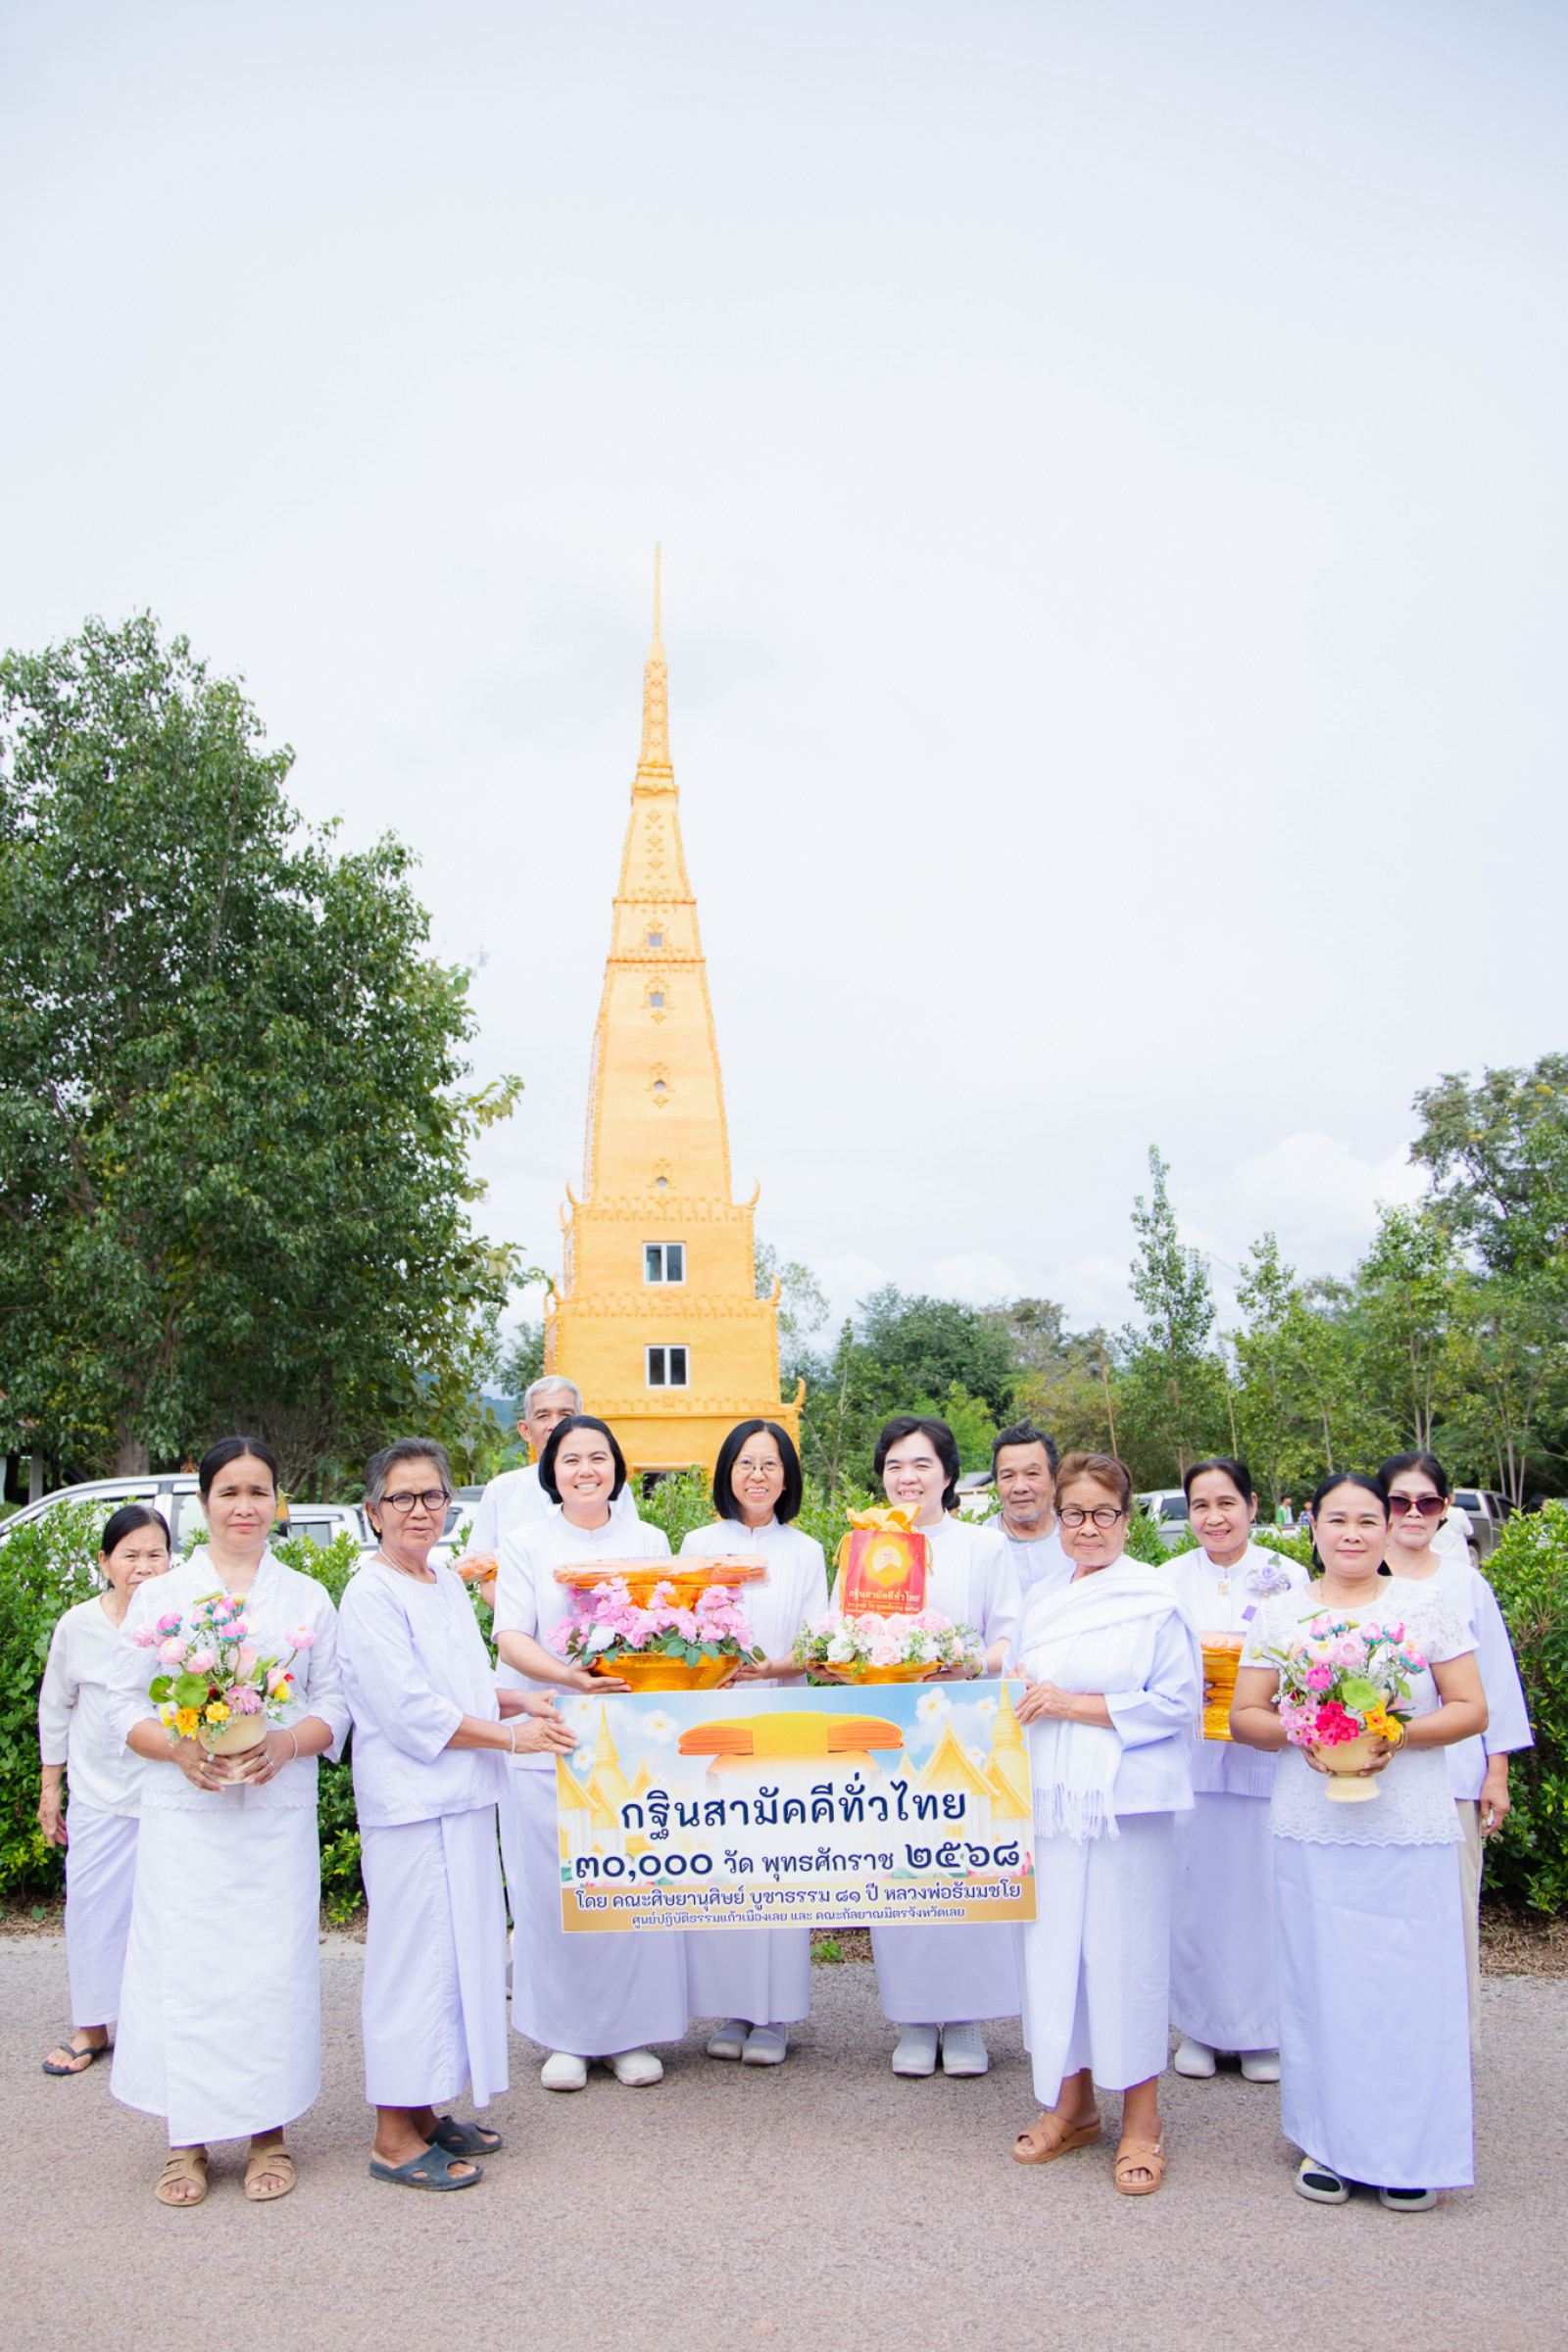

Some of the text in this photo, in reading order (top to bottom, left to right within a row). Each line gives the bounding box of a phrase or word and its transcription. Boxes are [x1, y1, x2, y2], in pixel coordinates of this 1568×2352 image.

[621, 1772, 966, 1839] กฐินสามัคคีทั่วไทย
[575, 1840, 1020, 1883] ๓๐,๐๐๐ วัด พุทธศักราช ๒๕๖๘
[575, 1879, 1021, 1911] โดย คณะศิษยานุศิษย์ บูชาธรรม ๘๑ ปี หลวงพ่อธัมมชโย
[632, 1905, 965, 1929] ศูนย์ปฏิบัติธรรมแก้วเมืองเลย และ คณะกัลยาณมิตรจังหวัดเลย
